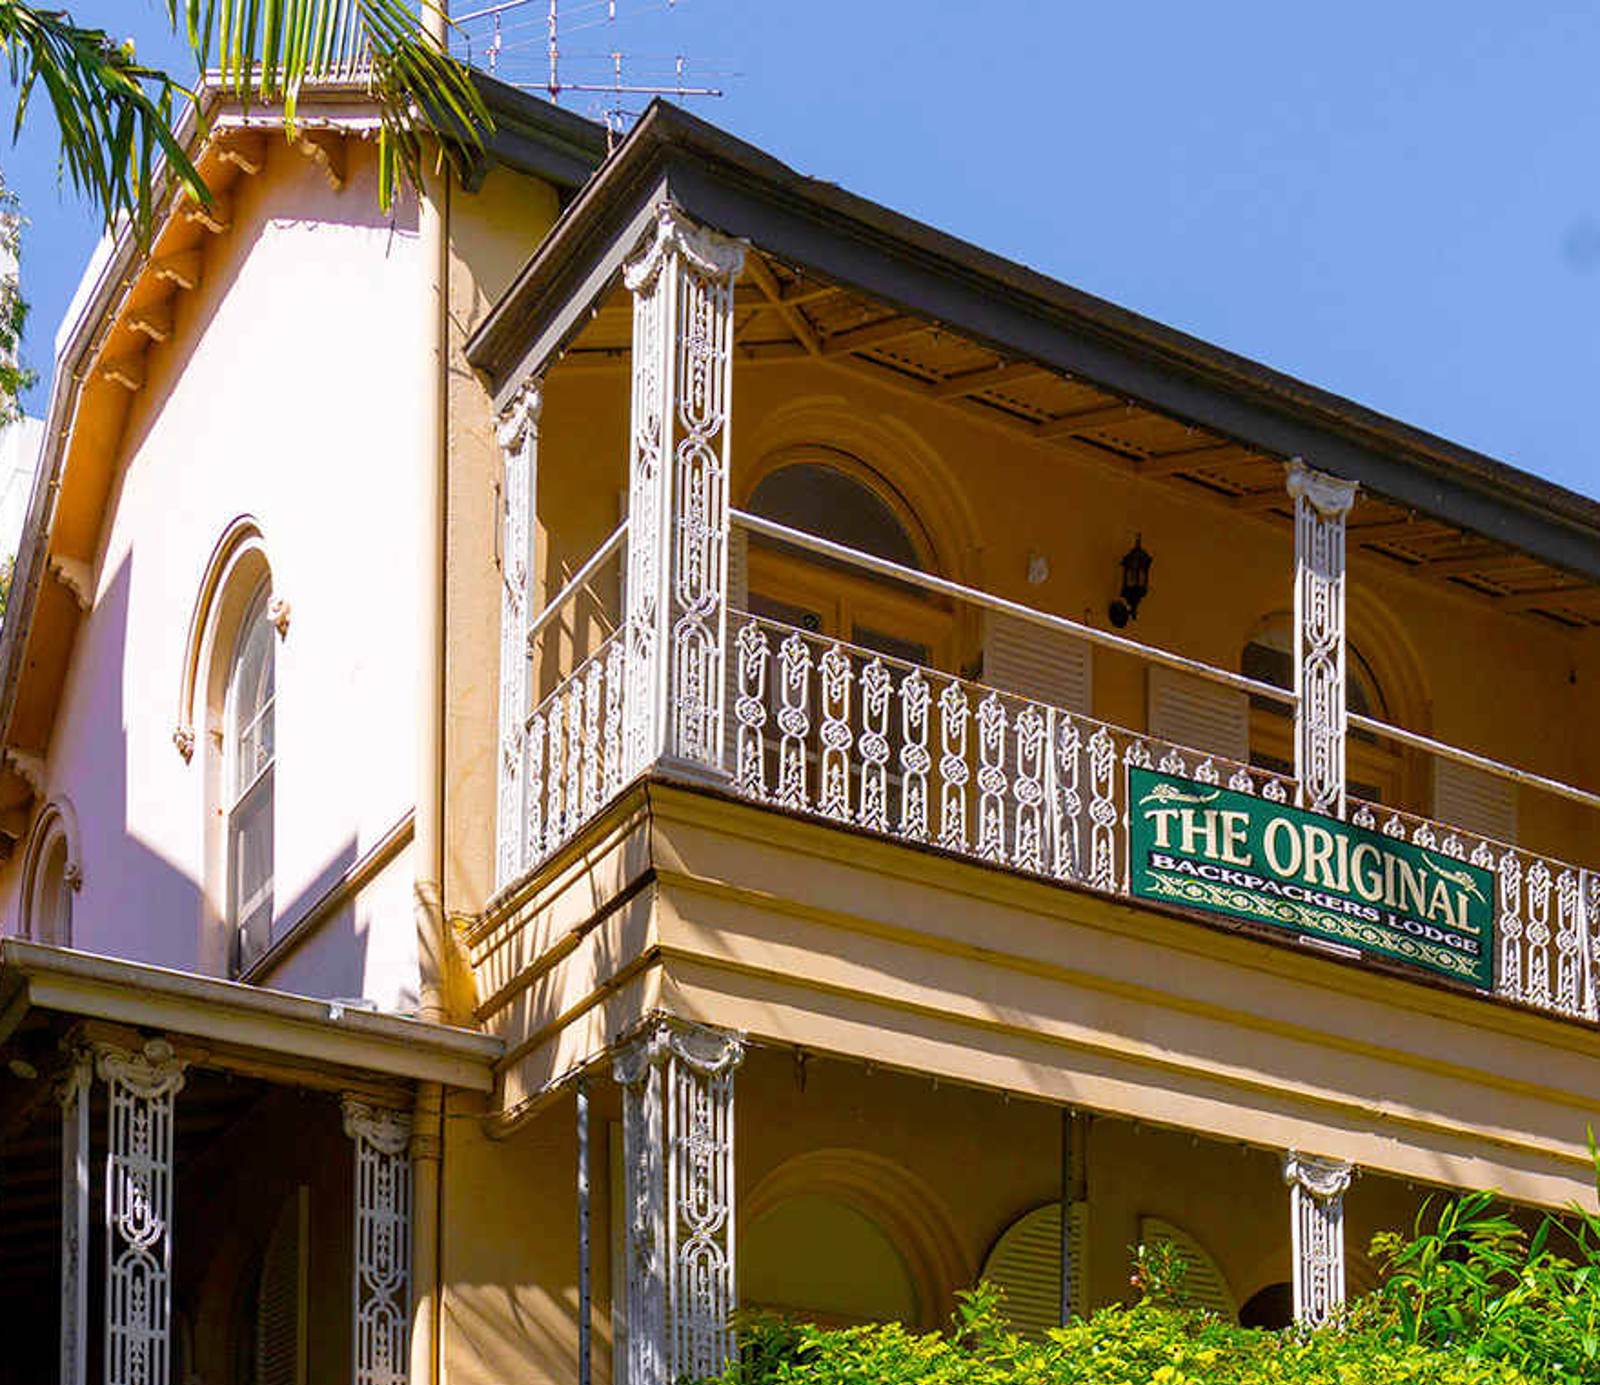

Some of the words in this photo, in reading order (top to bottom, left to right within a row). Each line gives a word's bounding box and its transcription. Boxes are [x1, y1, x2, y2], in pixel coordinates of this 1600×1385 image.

[1144, 808, 1252, 867] THE
[1263, 817, 1481, 934] ORIGINAL
[1152, 852, 1380, 923] BACKPACKERS
[1389, 914, 1480, 954] LODGE
